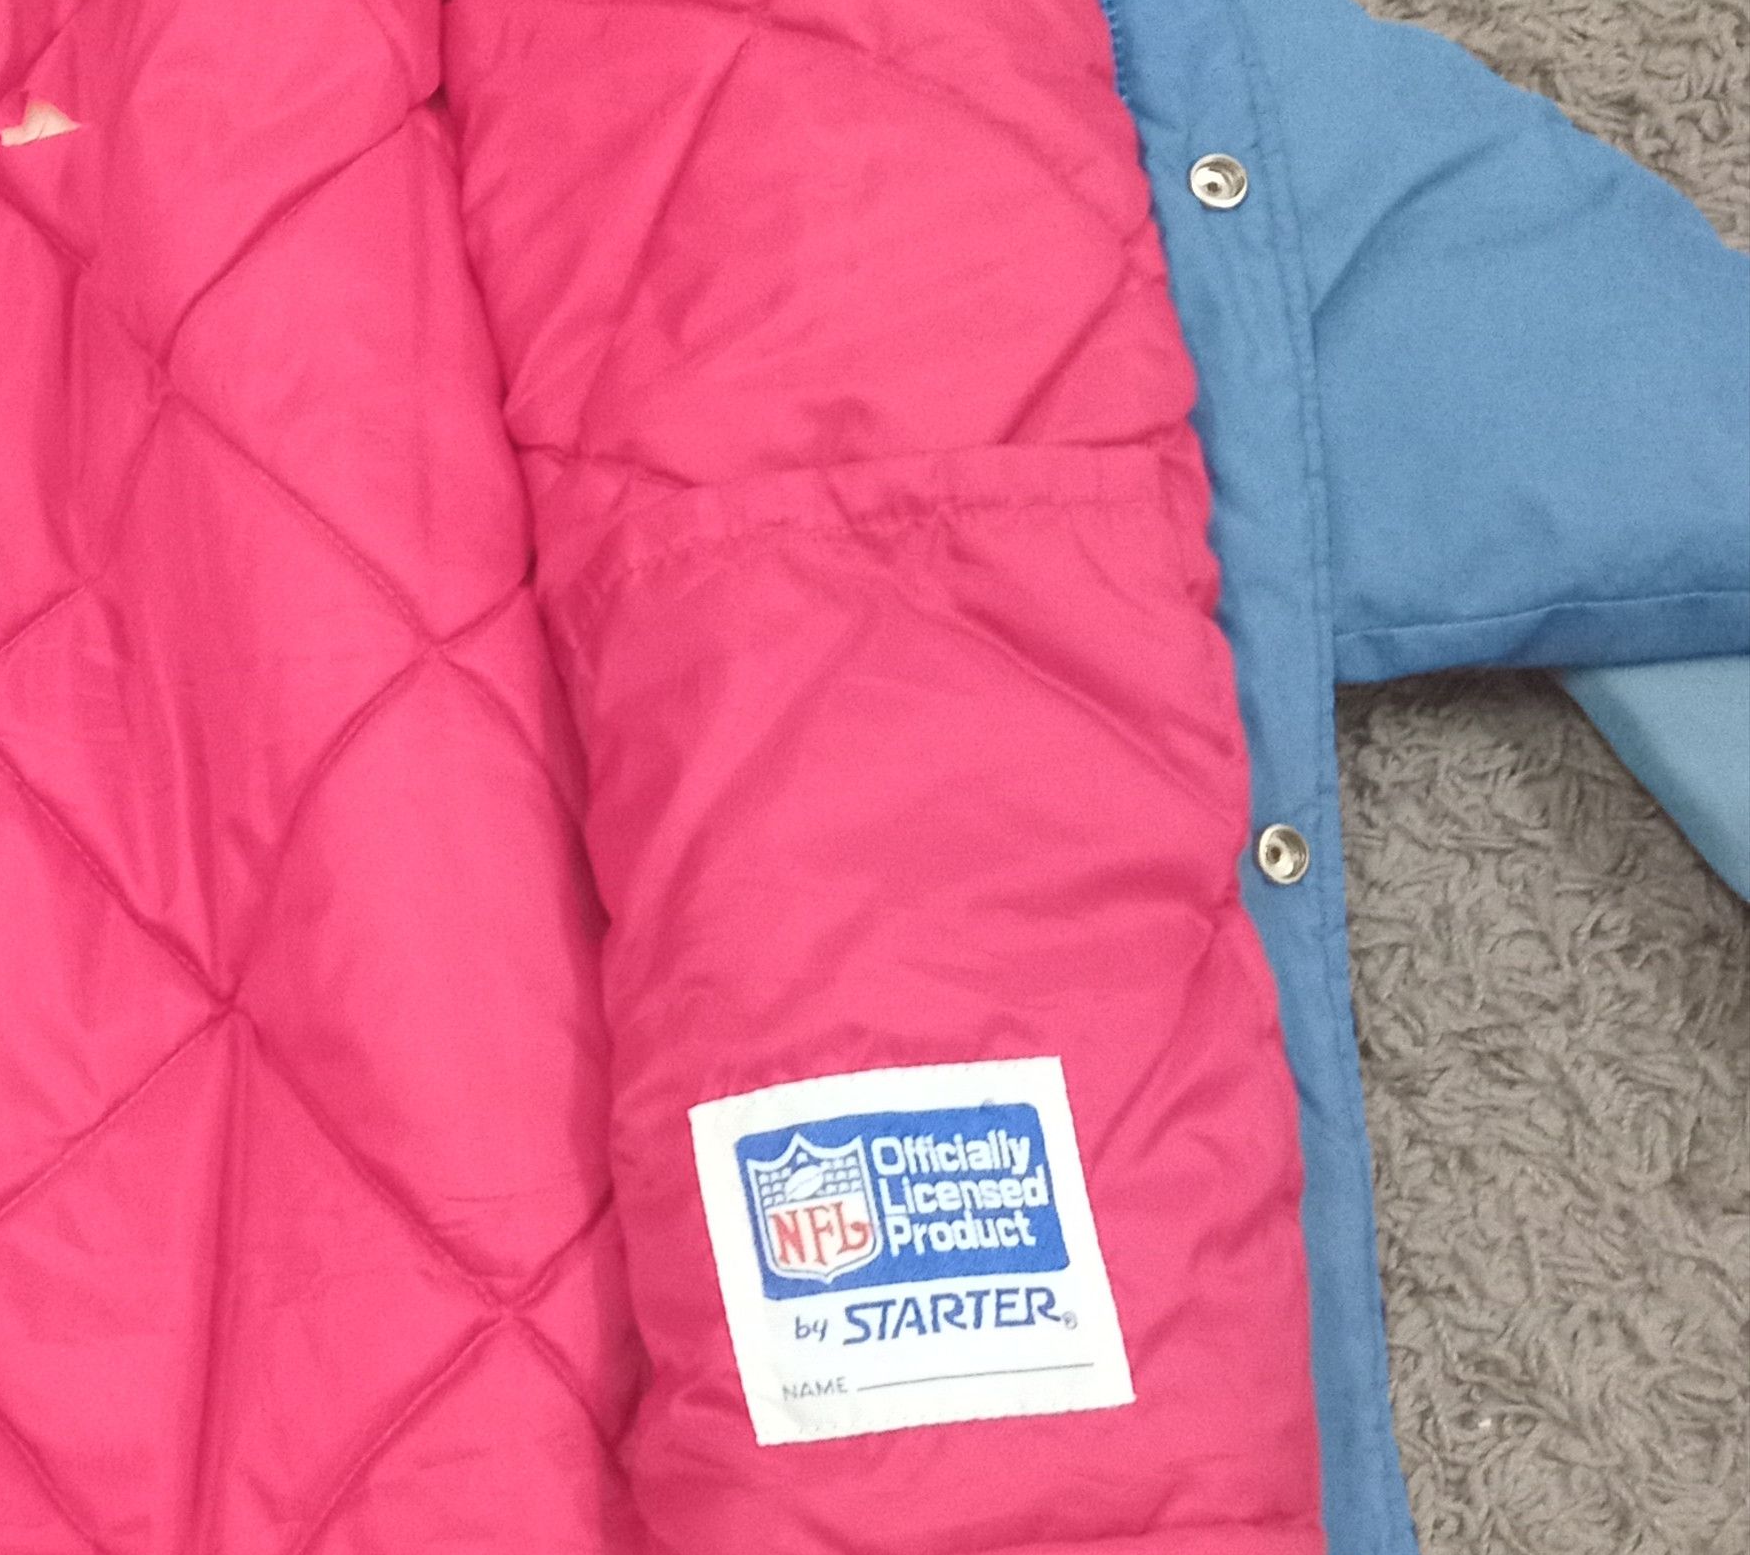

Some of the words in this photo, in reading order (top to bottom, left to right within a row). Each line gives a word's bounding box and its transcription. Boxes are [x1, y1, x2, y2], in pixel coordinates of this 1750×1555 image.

[871, 1130, 1031, 1175] Officially
[878, 1165, 1049, 1215] Licensed
[769, 1201, 871, 1266] NFL
[885, 1212, 1036, 1257] Product
[794, 1315, 828, 1342] by
[781, 1376, 848, 1402] NAME
